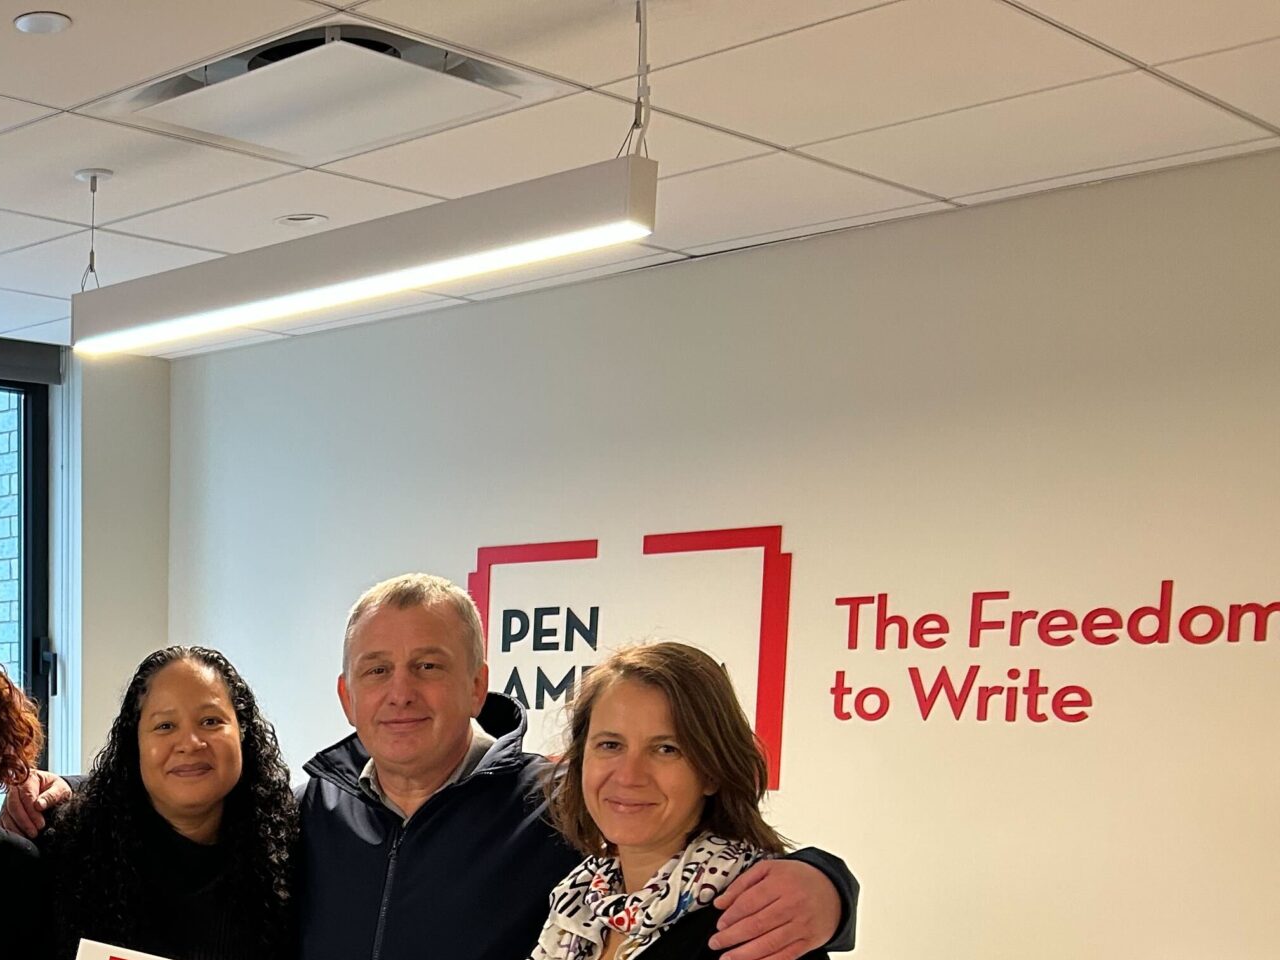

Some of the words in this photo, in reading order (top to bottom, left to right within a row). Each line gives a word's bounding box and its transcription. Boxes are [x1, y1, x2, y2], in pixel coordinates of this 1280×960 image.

[501, 606, 600, 652] PEN
[835, 593, 950, 650] The
[969, 580, 1280, 648] Freedom
[830, 670, 890, 721] to
[908, 665, 1092, 723] Write
